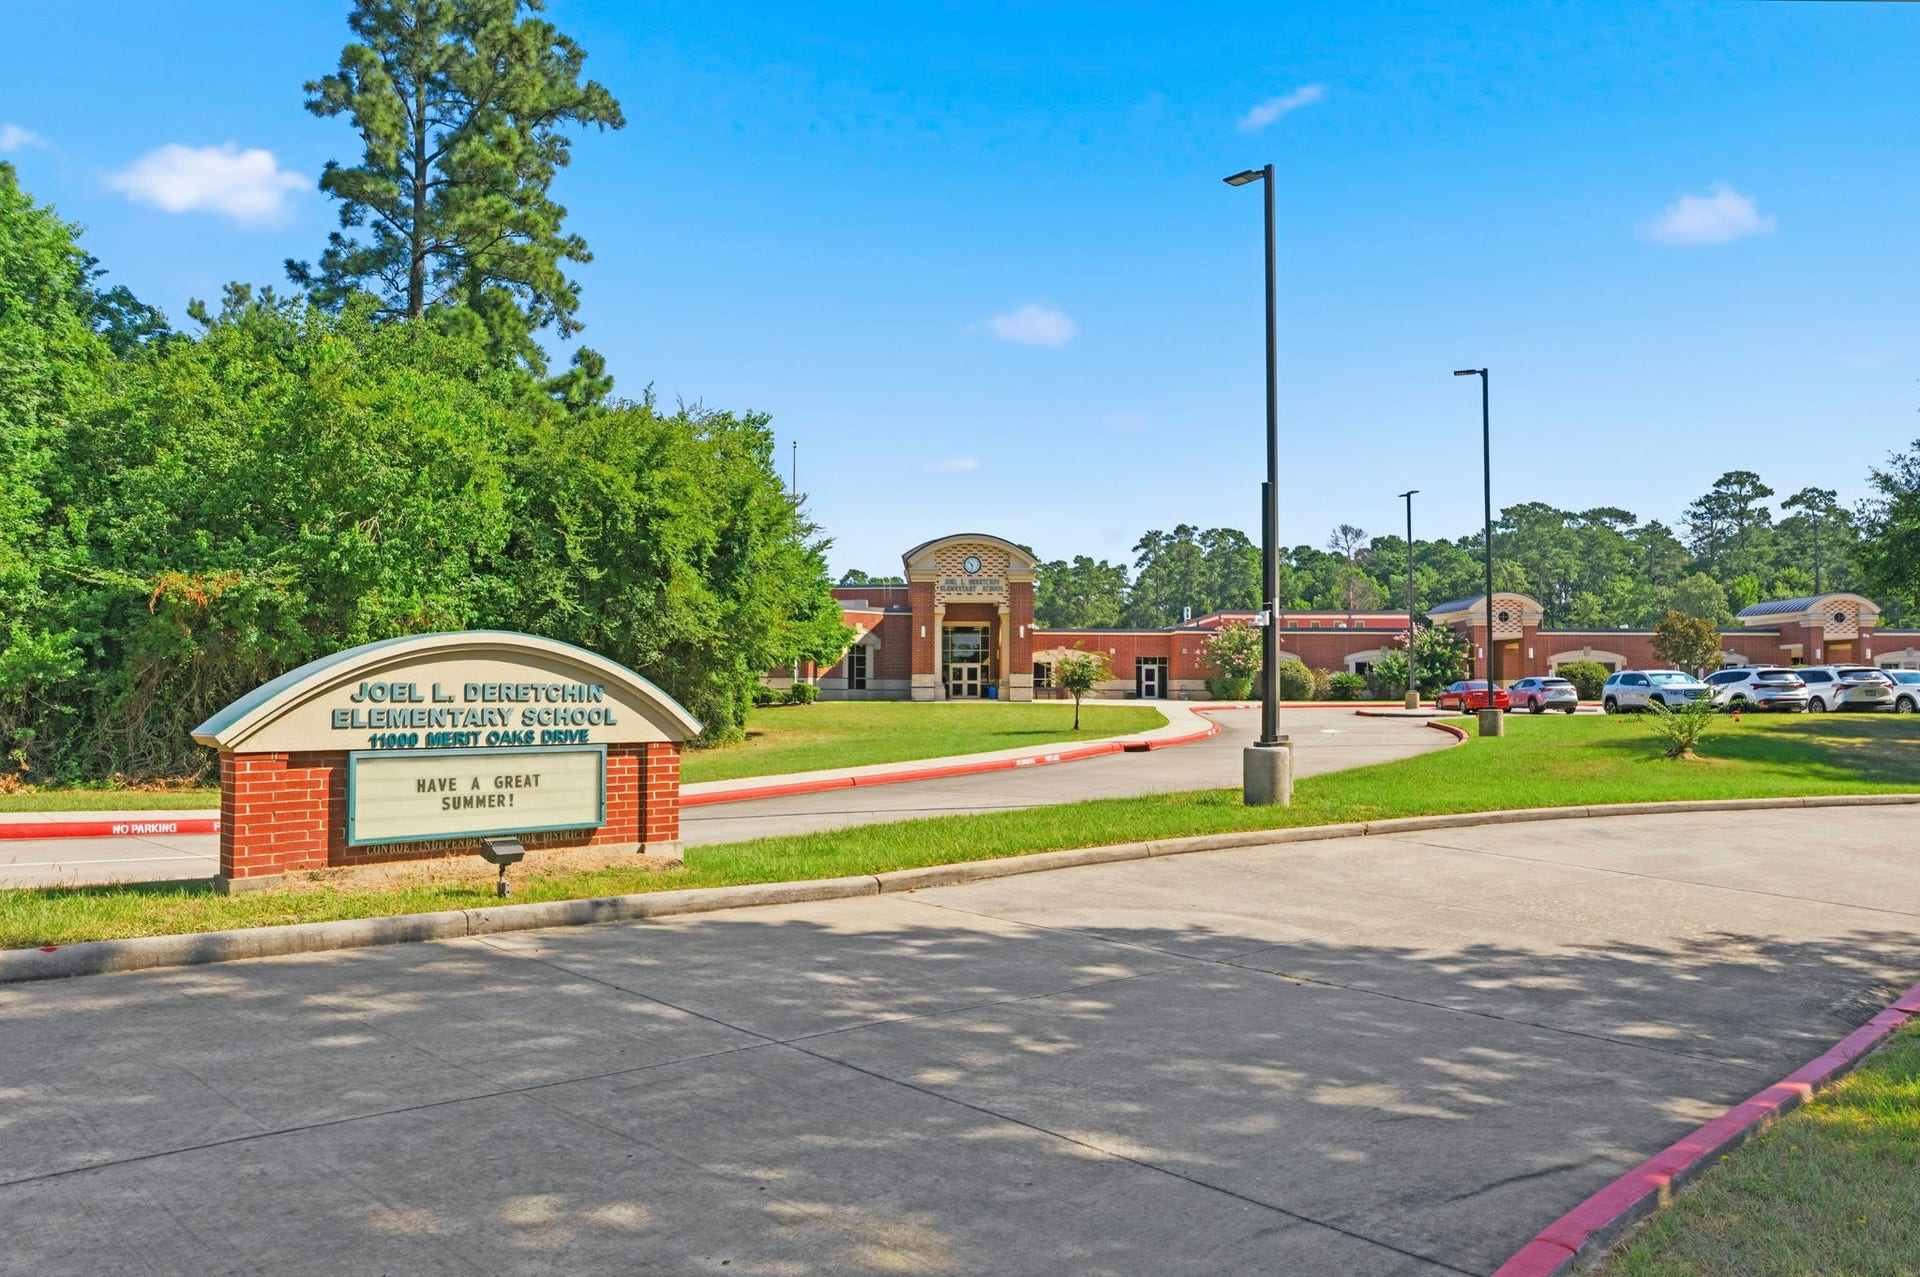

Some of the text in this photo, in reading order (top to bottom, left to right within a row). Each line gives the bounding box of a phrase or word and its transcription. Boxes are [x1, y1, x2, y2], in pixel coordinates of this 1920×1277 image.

[350, 682, 605, 703] JOEL L. DERETCHIN
[332, 707, 617, 729] ELEMENTARY SCHOOL
[368, 728, 590, 749] 11000 MERIT OAKS DRIVE
[416, 774, 541, 793] HAVE A GREAT
[441, 793, 514, 811] SUMMER!
[112, 823, 177, 834] NO PARKING
[419, 836, 484, 851] INDEPENDEN
